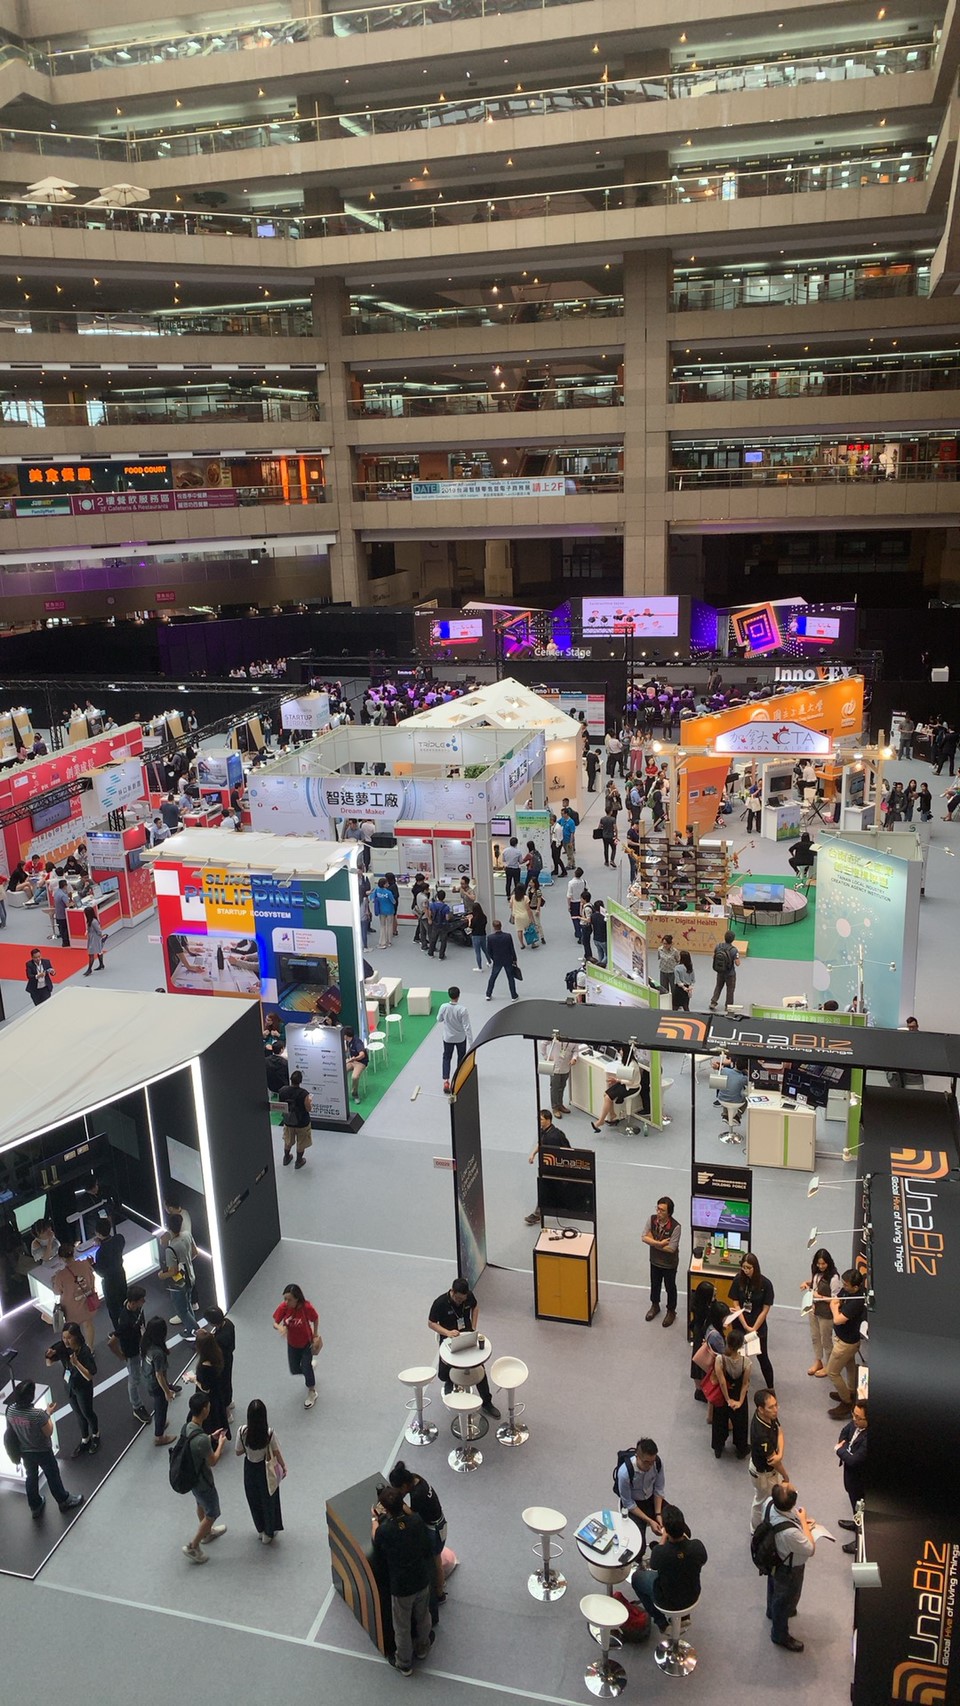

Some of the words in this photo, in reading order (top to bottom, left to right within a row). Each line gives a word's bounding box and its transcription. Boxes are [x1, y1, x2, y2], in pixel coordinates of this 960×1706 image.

[532, 482, 564, 492] 請上2F
[534, 648, 563, 656] Center
[566, 647, 591, 658] Stage
[774, 666, 852, 681] InnoVEX
[778, 731, 814, 744] CTA
[326, 790, 398, 808] 智造夢工廠
[184, 886, 320, 910] PHILIPPINES
[250, 910, 291, 919] ECOSYSTEM
[709, 1025, 853, 1049] UnaBiz
[556, 1158, 590, 1168] UnaBiz
[892, 1176, 900, 1195] Global
[892, 1194, 901, 1212] Hive
[894, 1212, 902, 1220] of
[893, 1221, 902, 1244] Living
[905, 1178, 944, 1276] UnaBiz
[895, 1245, 904, 1273] Things
[761, 1443, 768, 1452] 7
[950, 1544, 960, 1575] Things
[947, 1578, 959, 1605] Living
[908, 1540, 946, 1663] UnaBiz
[947, 1607, 954, 1617] of
[942, 1639, 951, 1666] Global
